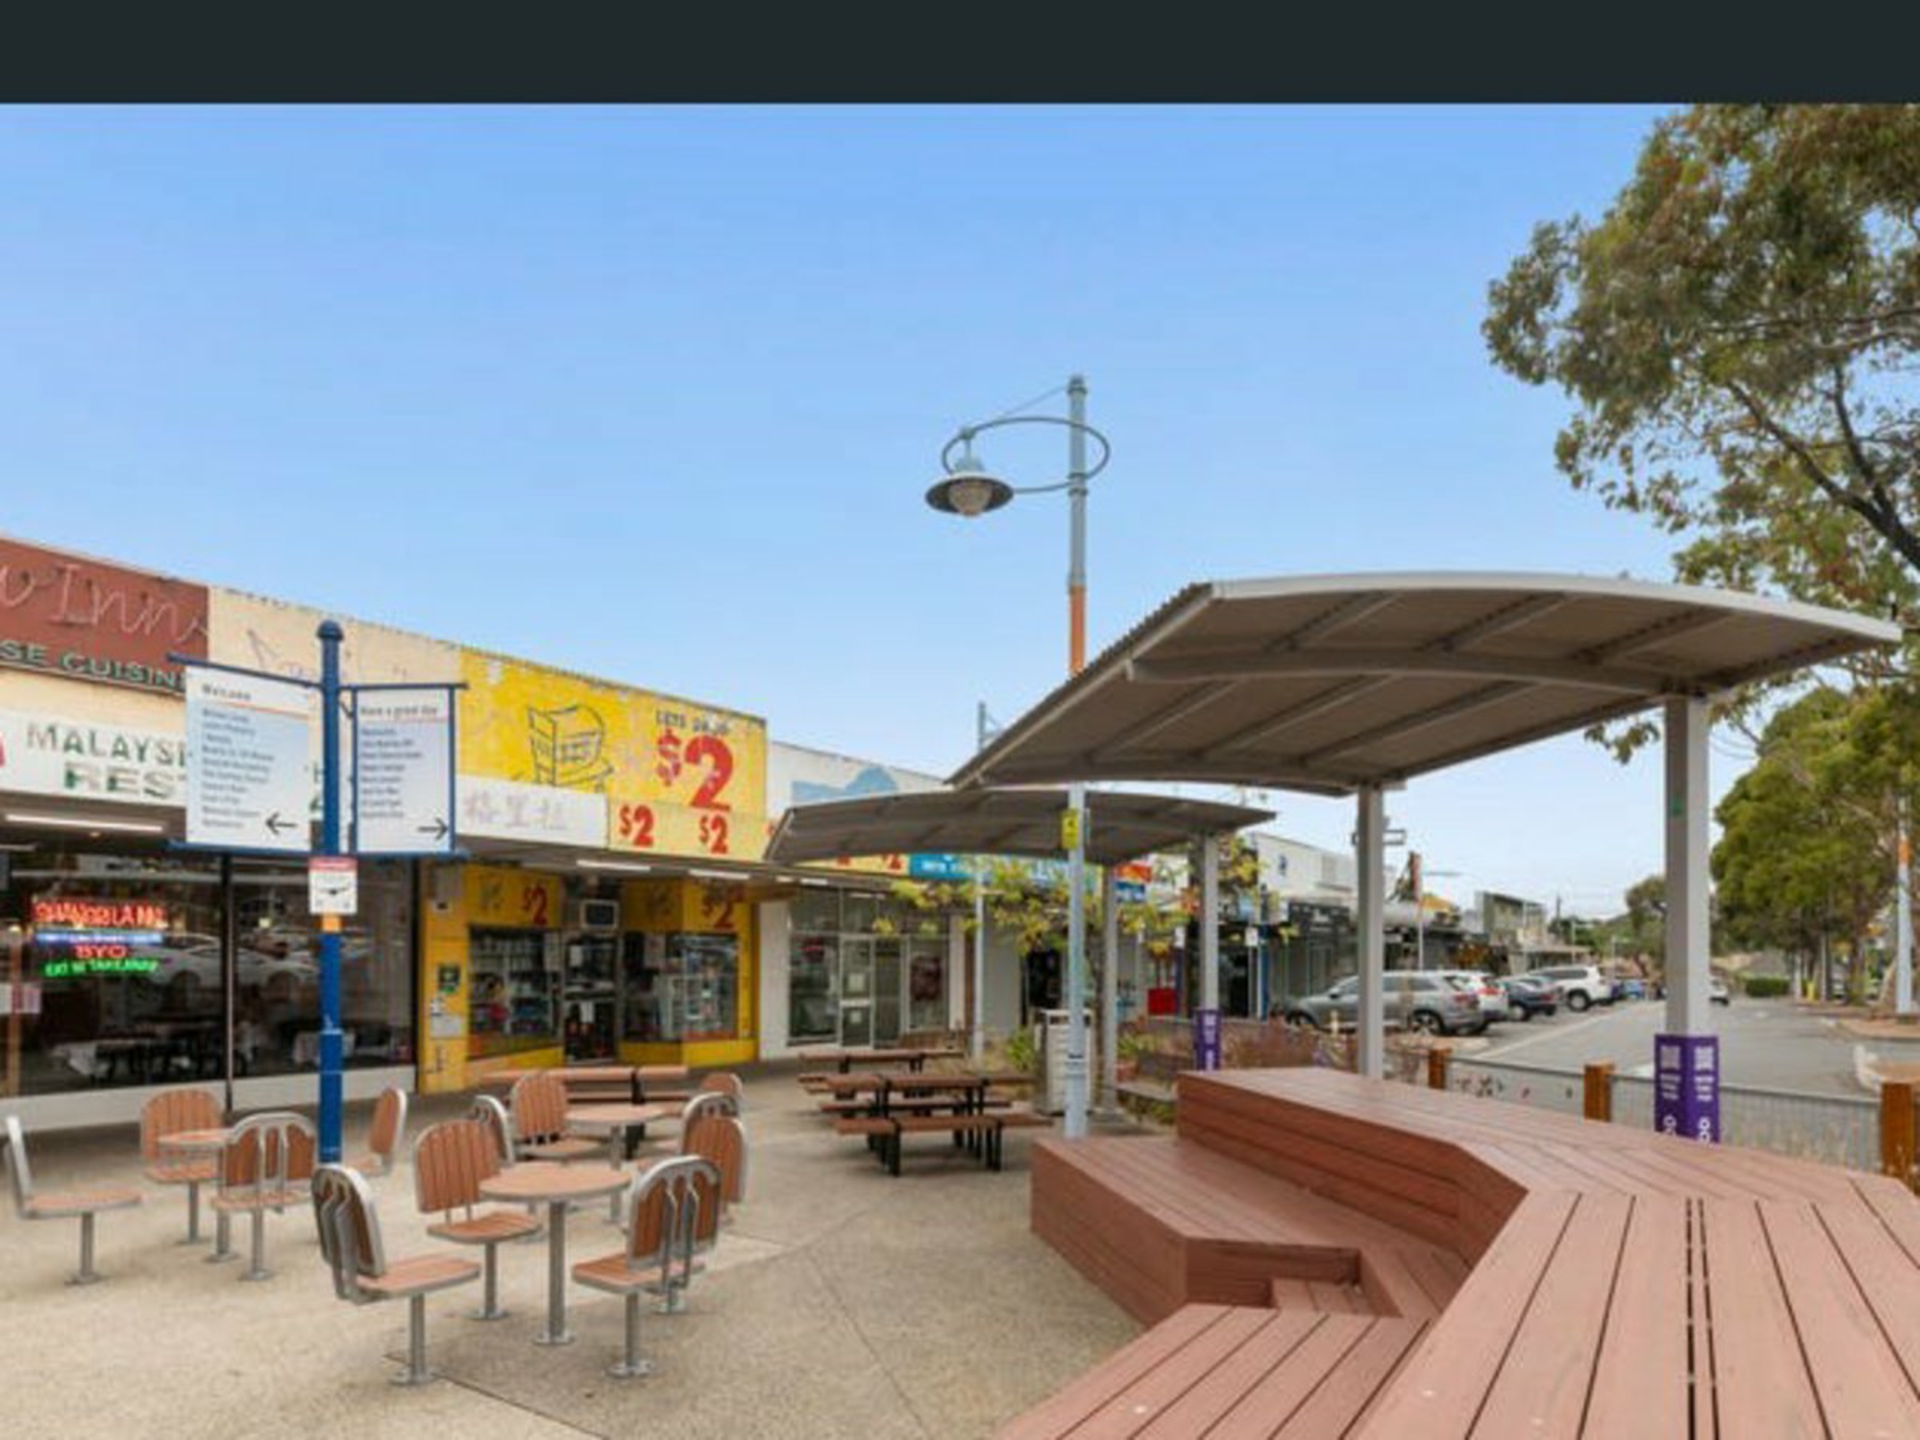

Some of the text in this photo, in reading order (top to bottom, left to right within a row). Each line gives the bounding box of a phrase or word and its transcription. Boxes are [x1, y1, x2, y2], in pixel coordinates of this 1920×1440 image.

[656, 728, 734, 811] $2
[618, 804, 655, 847] $2
[699, 815, 728, 854] $2
[522, 882, 549, 927] $2
[74, 944, 128, 958] BYO
